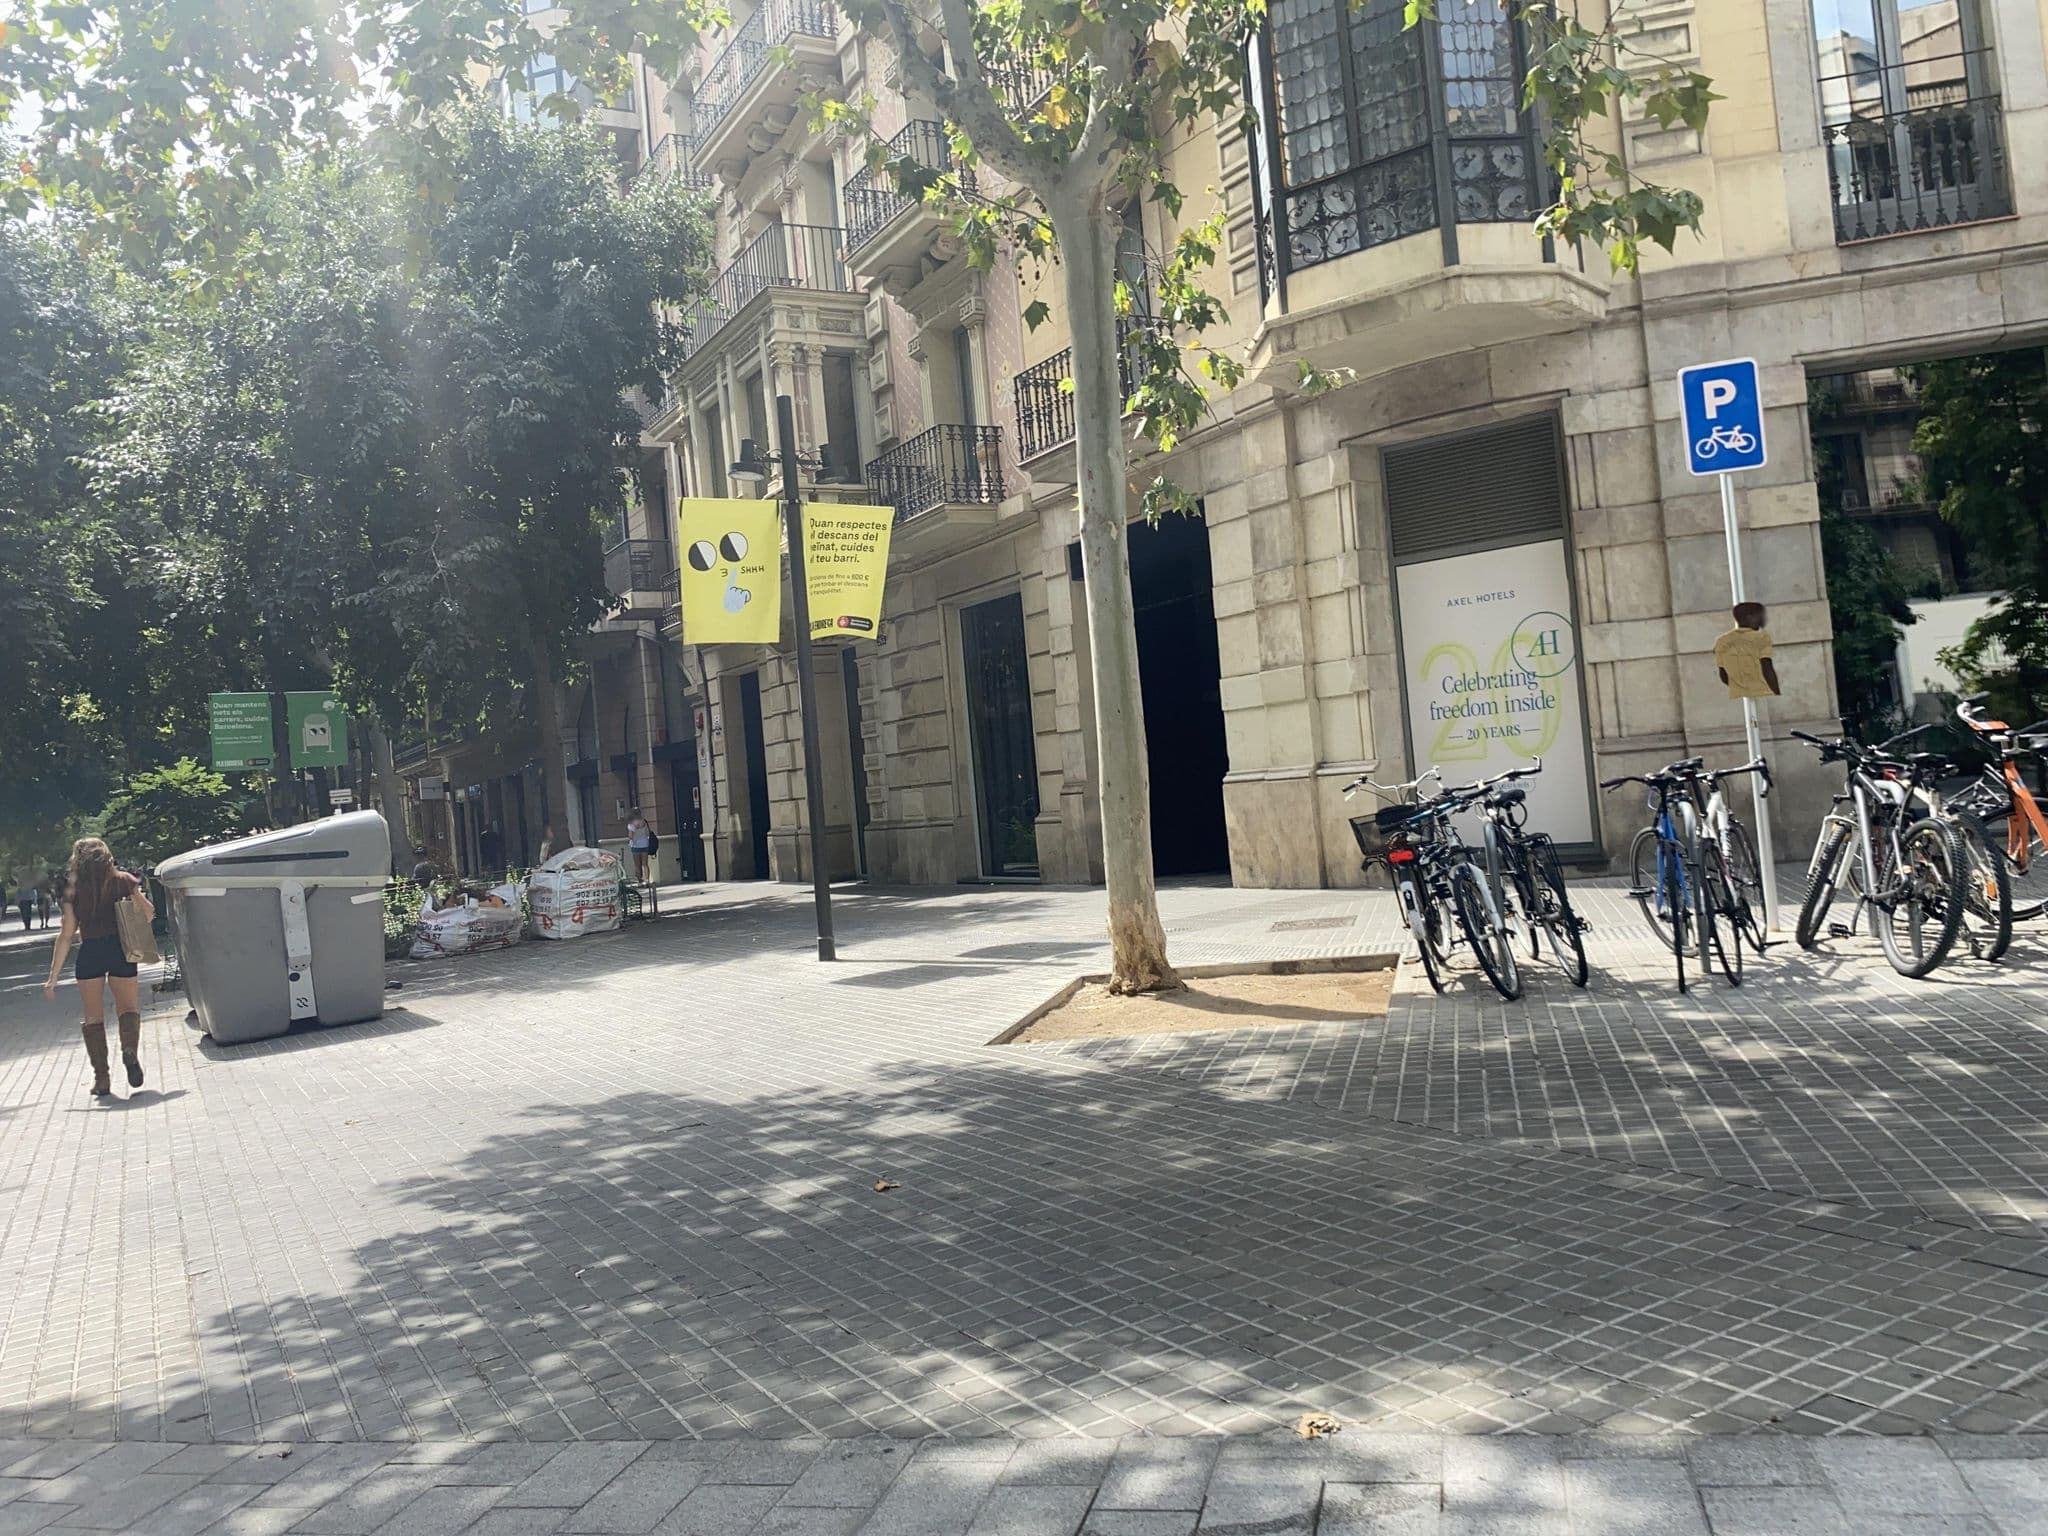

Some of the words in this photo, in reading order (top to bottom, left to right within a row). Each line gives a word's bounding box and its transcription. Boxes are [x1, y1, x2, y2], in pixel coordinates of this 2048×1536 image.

[1702, 378, 1737, 420] P
[810, 518, 834, 530] Quan
[836, 521, 888, 531] respectes
[818, 530, 860, 540] descans
[862, 532, 879, 542] del
[810, 542, 838, 552] eïnat,
[840, 542, 875, 553] cuides
[816, 554, 832, 563] teu
[834, 553, 860, 563] barri.
[740, 565, 765, 575] SHHH
[1447, 597, 1473, 607] AXEL
[1476, 590, 1516, 603] HOTELS
[1442, 669, 1539, 695] Celebrating
[1430, 698, 1499, 720] freedom
[1504, 689, 1556, 713] inside
[1466, 727, 1480, 740] 20
[1482, 723, 1521, 738] YEARS
